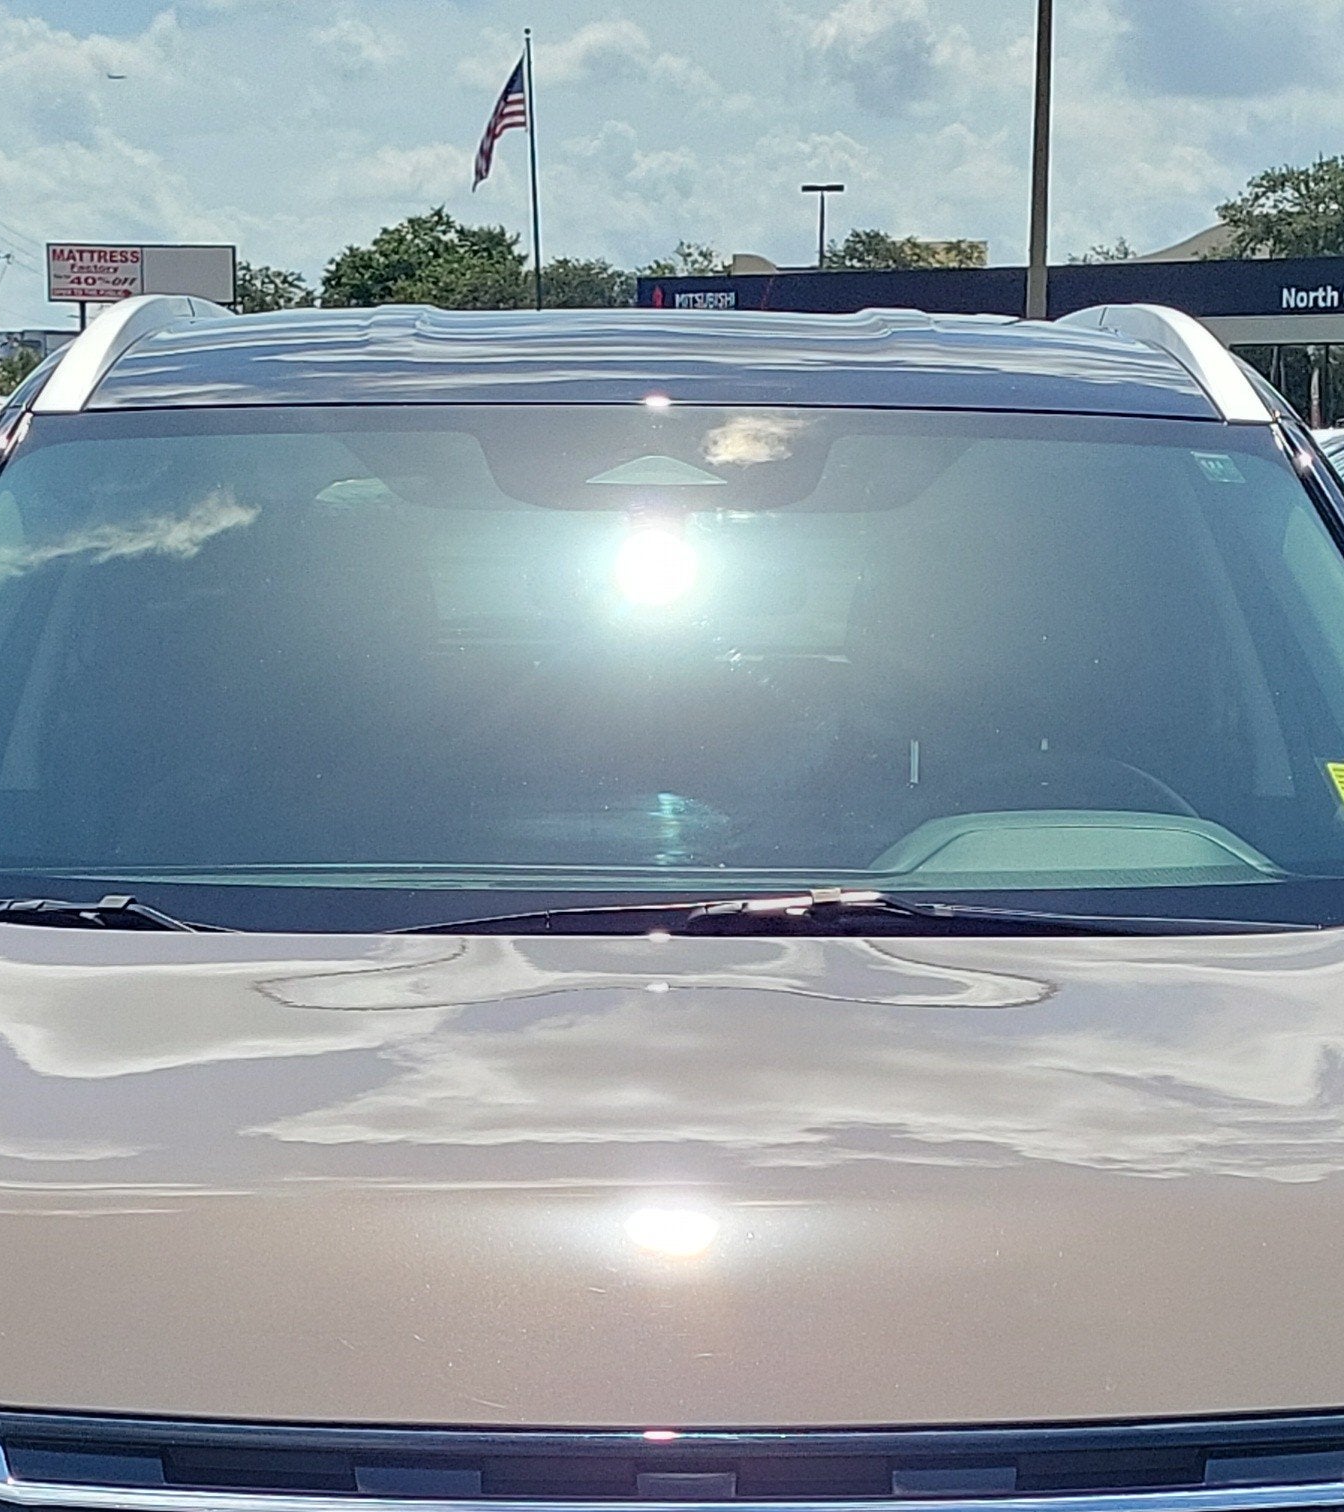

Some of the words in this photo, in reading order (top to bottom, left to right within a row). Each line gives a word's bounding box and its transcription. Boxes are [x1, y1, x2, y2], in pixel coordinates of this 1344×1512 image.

[51, 248, 140, 263] MATTRESS
[70, 264, 119, 273] Factory
[675, 292, 736, 310] MITSUBISHI
[1281, 285, 1339, 308] North
